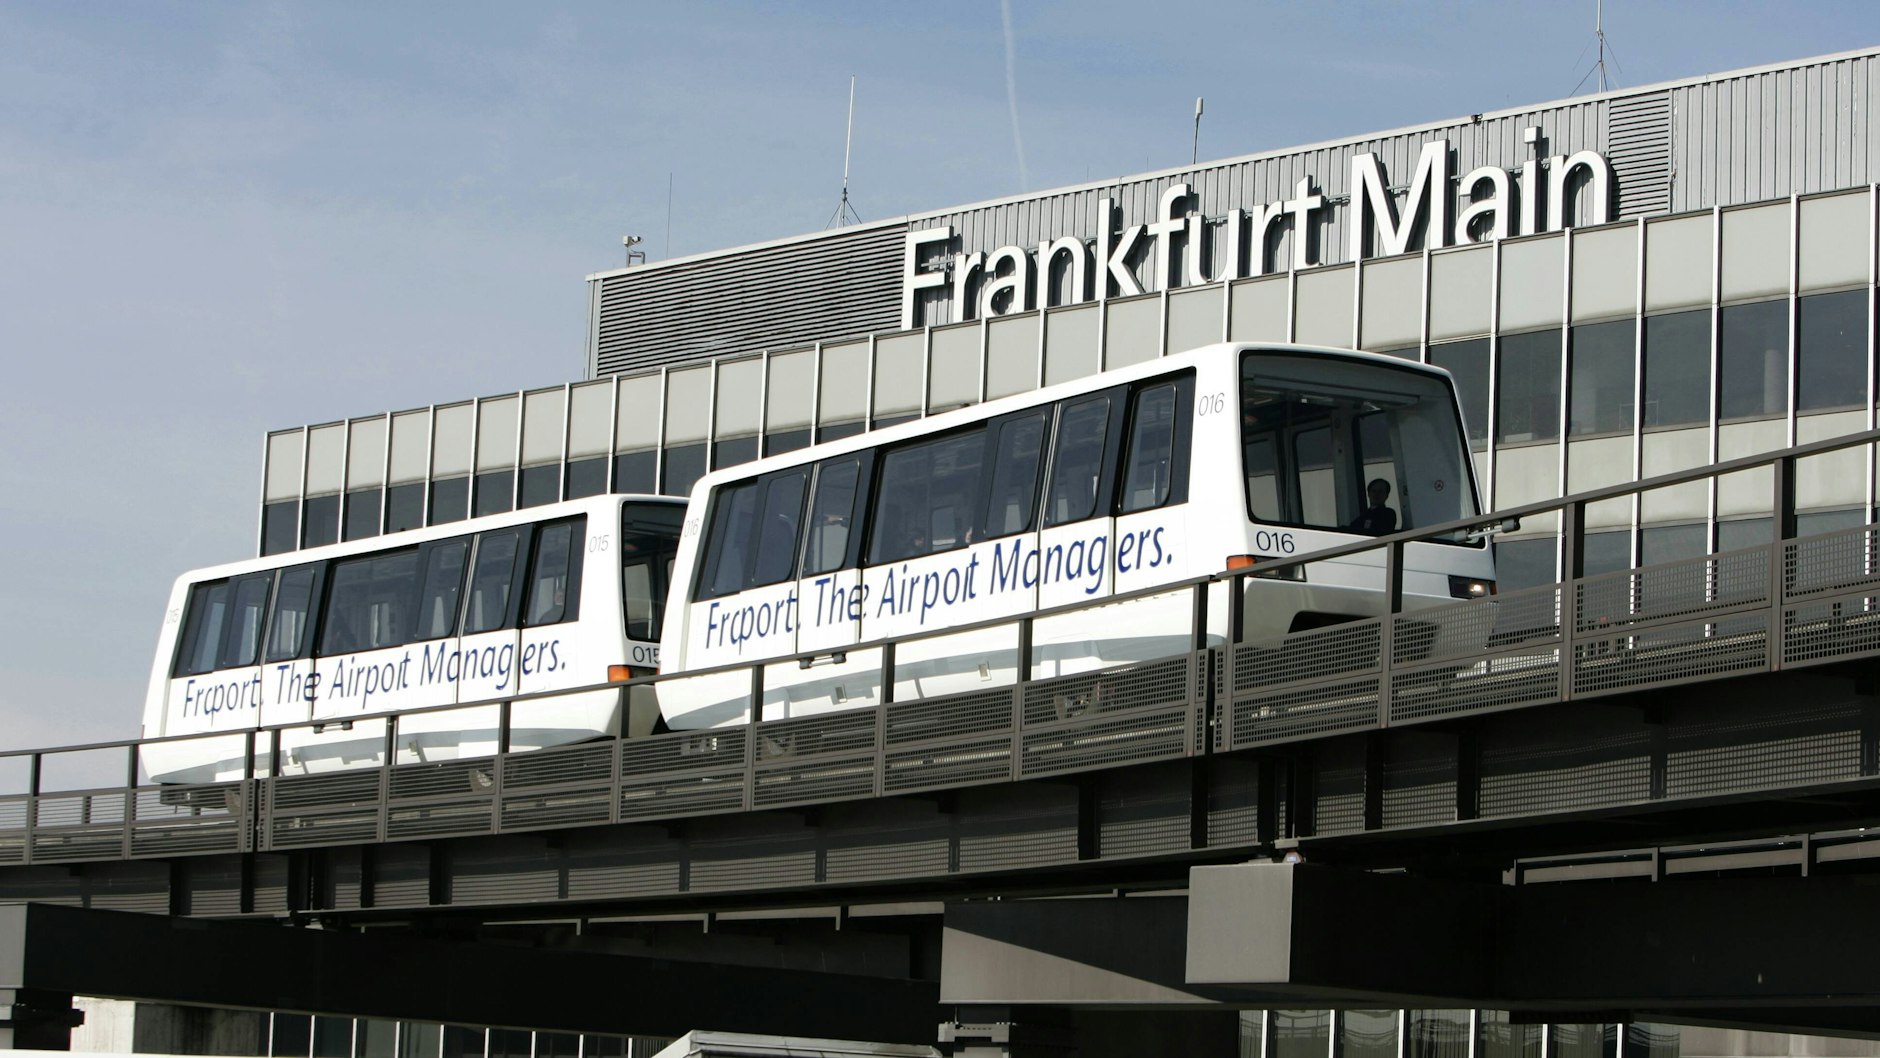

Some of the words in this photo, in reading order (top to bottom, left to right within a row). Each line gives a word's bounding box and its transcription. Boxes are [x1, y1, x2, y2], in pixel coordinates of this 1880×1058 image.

[901, 175, 1323, 331] Frankfurt
[1349, 126, 1611, 260] Main
[1198, 392, 1225, 417] 016
[684, 518, 700, 537] 016
[589, 535, 609, 552] 015
[1256, 531, 1295, 553] 016
[815, 573, 870, 628] The
[876, 551, 979, 625] Airport
[989, 526, 1173, 595] Managers.
[632, 646, 661, 665] 015
[277, 663, 321, 705] The
[328, 650, 411, 710] Airport
[419, 639, 566, 690] Managers.
